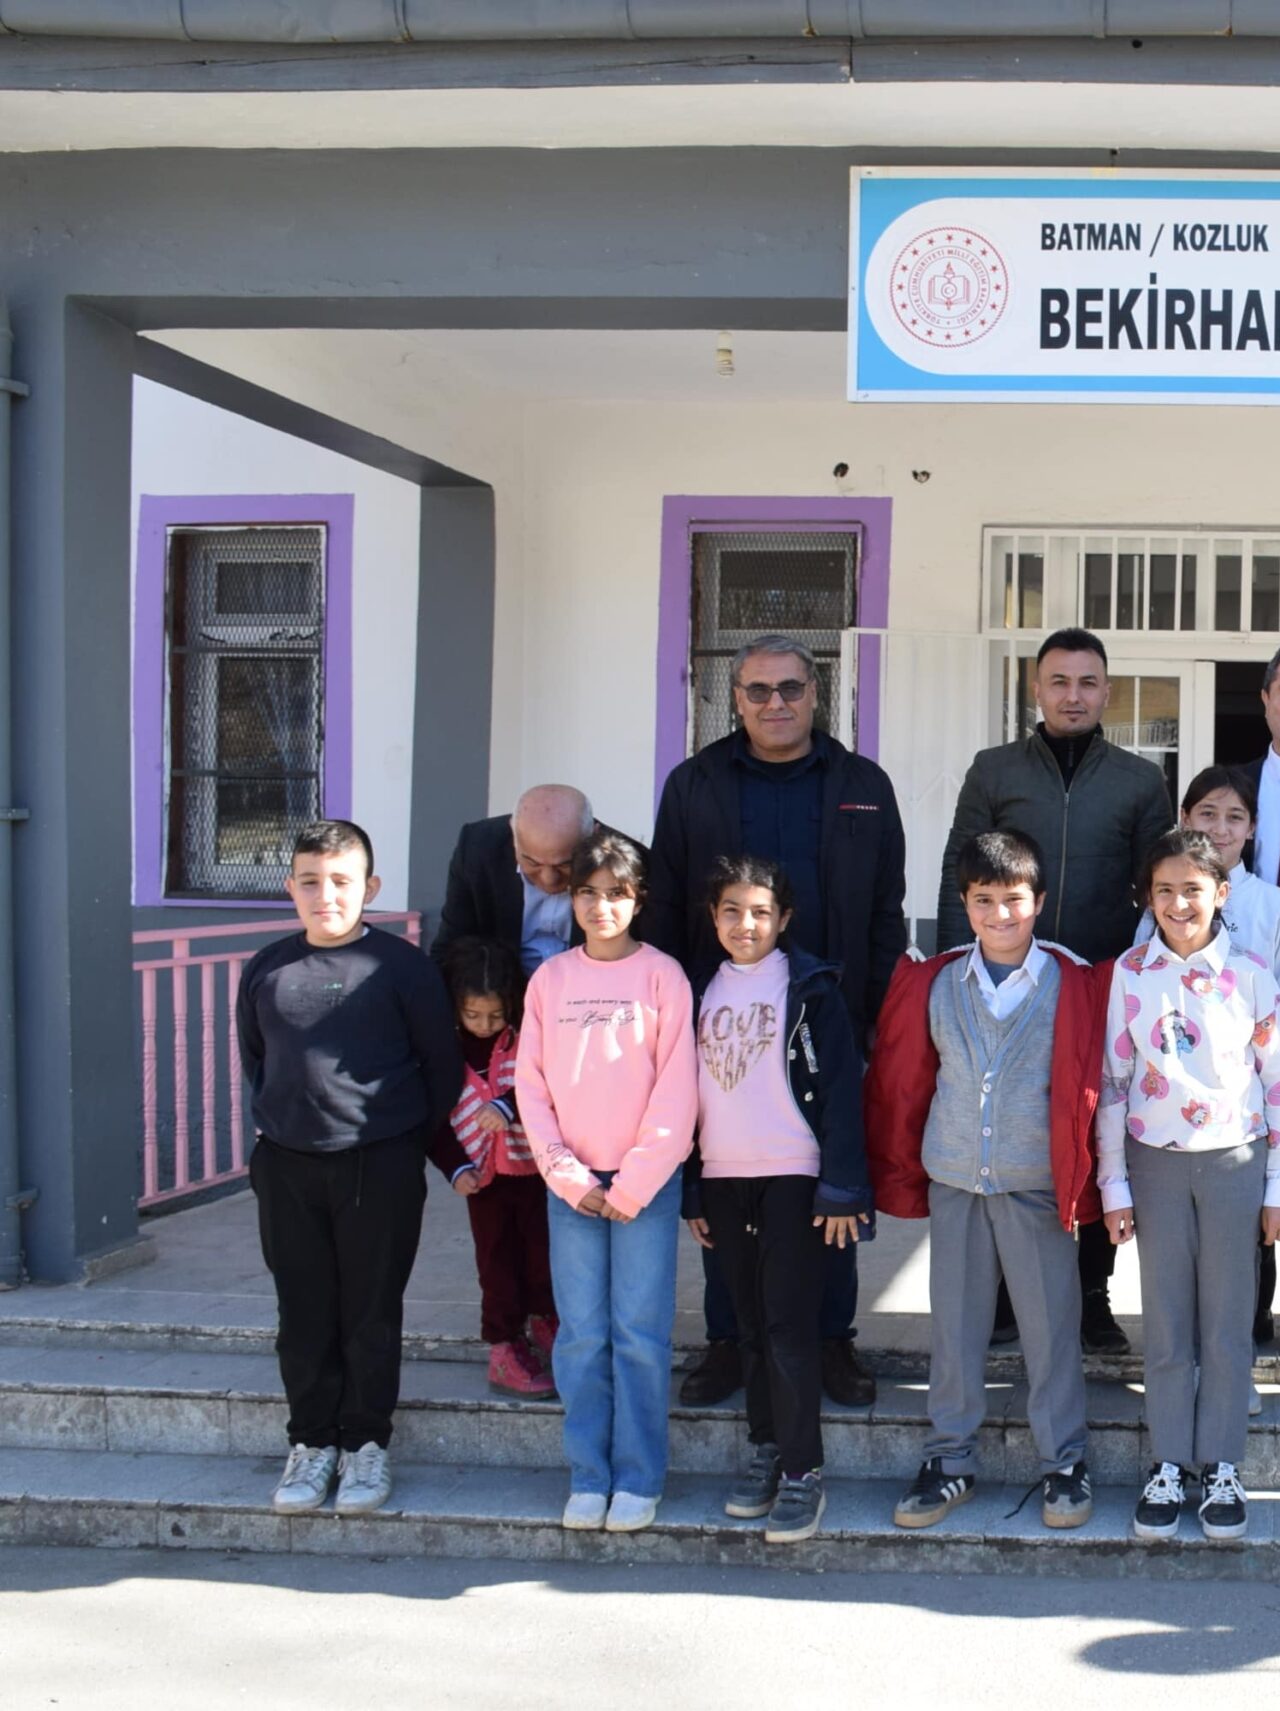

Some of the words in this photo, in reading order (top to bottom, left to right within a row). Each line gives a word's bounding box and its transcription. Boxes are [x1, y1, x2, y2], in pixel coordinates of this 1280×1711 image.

[1040, 222, 1141, 251] BATMAN
[1149, 222, 1165, 258] /
[1172, 223, 1270, 253] KOZLUK
[911, 250, 945, 296] CUMHURİYETİ
[697, 1001, 777, 1046] LOVE
